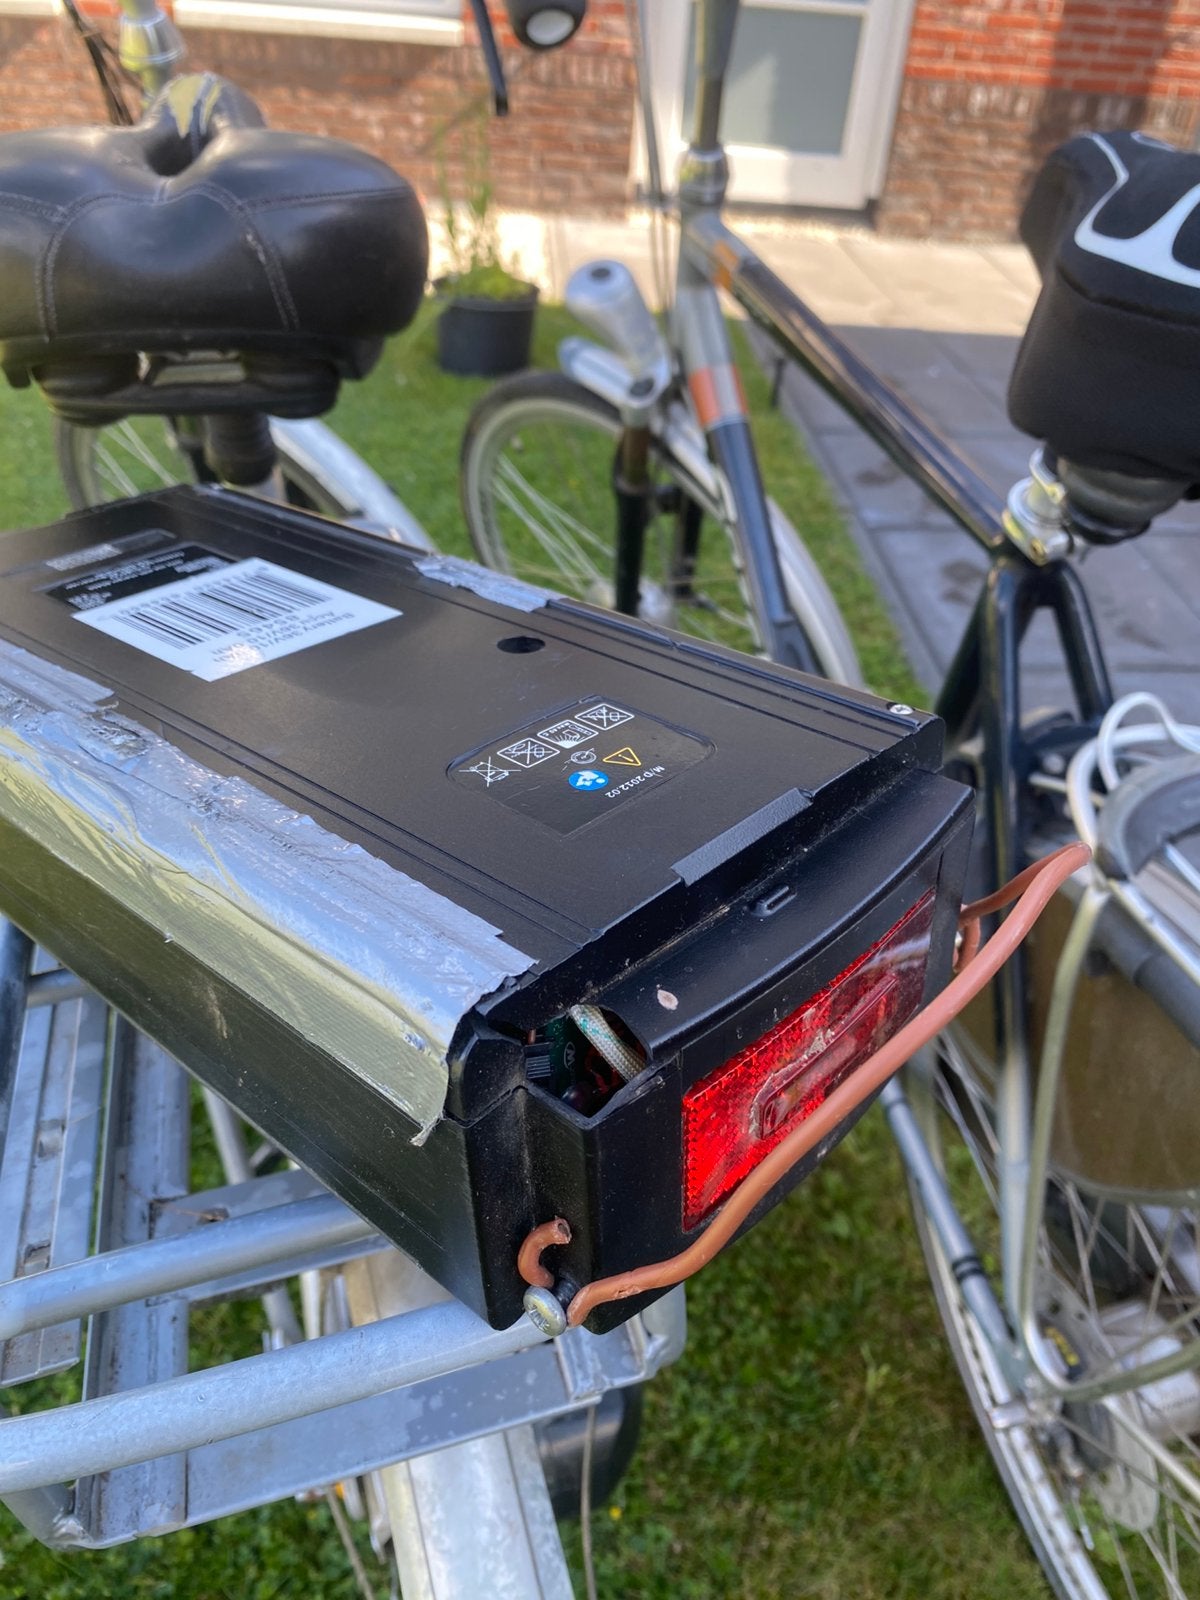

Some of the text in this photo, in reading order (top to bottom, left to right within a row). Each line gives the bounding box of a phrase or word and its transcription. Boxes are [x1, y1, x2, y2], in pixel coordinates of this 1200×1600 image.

[212, 623, 300, 654] 36V/100Ah
[213, 612, 355, 663] Battery 36V/10Ah
[605, 765, 665, 798] M/D 2012.02
